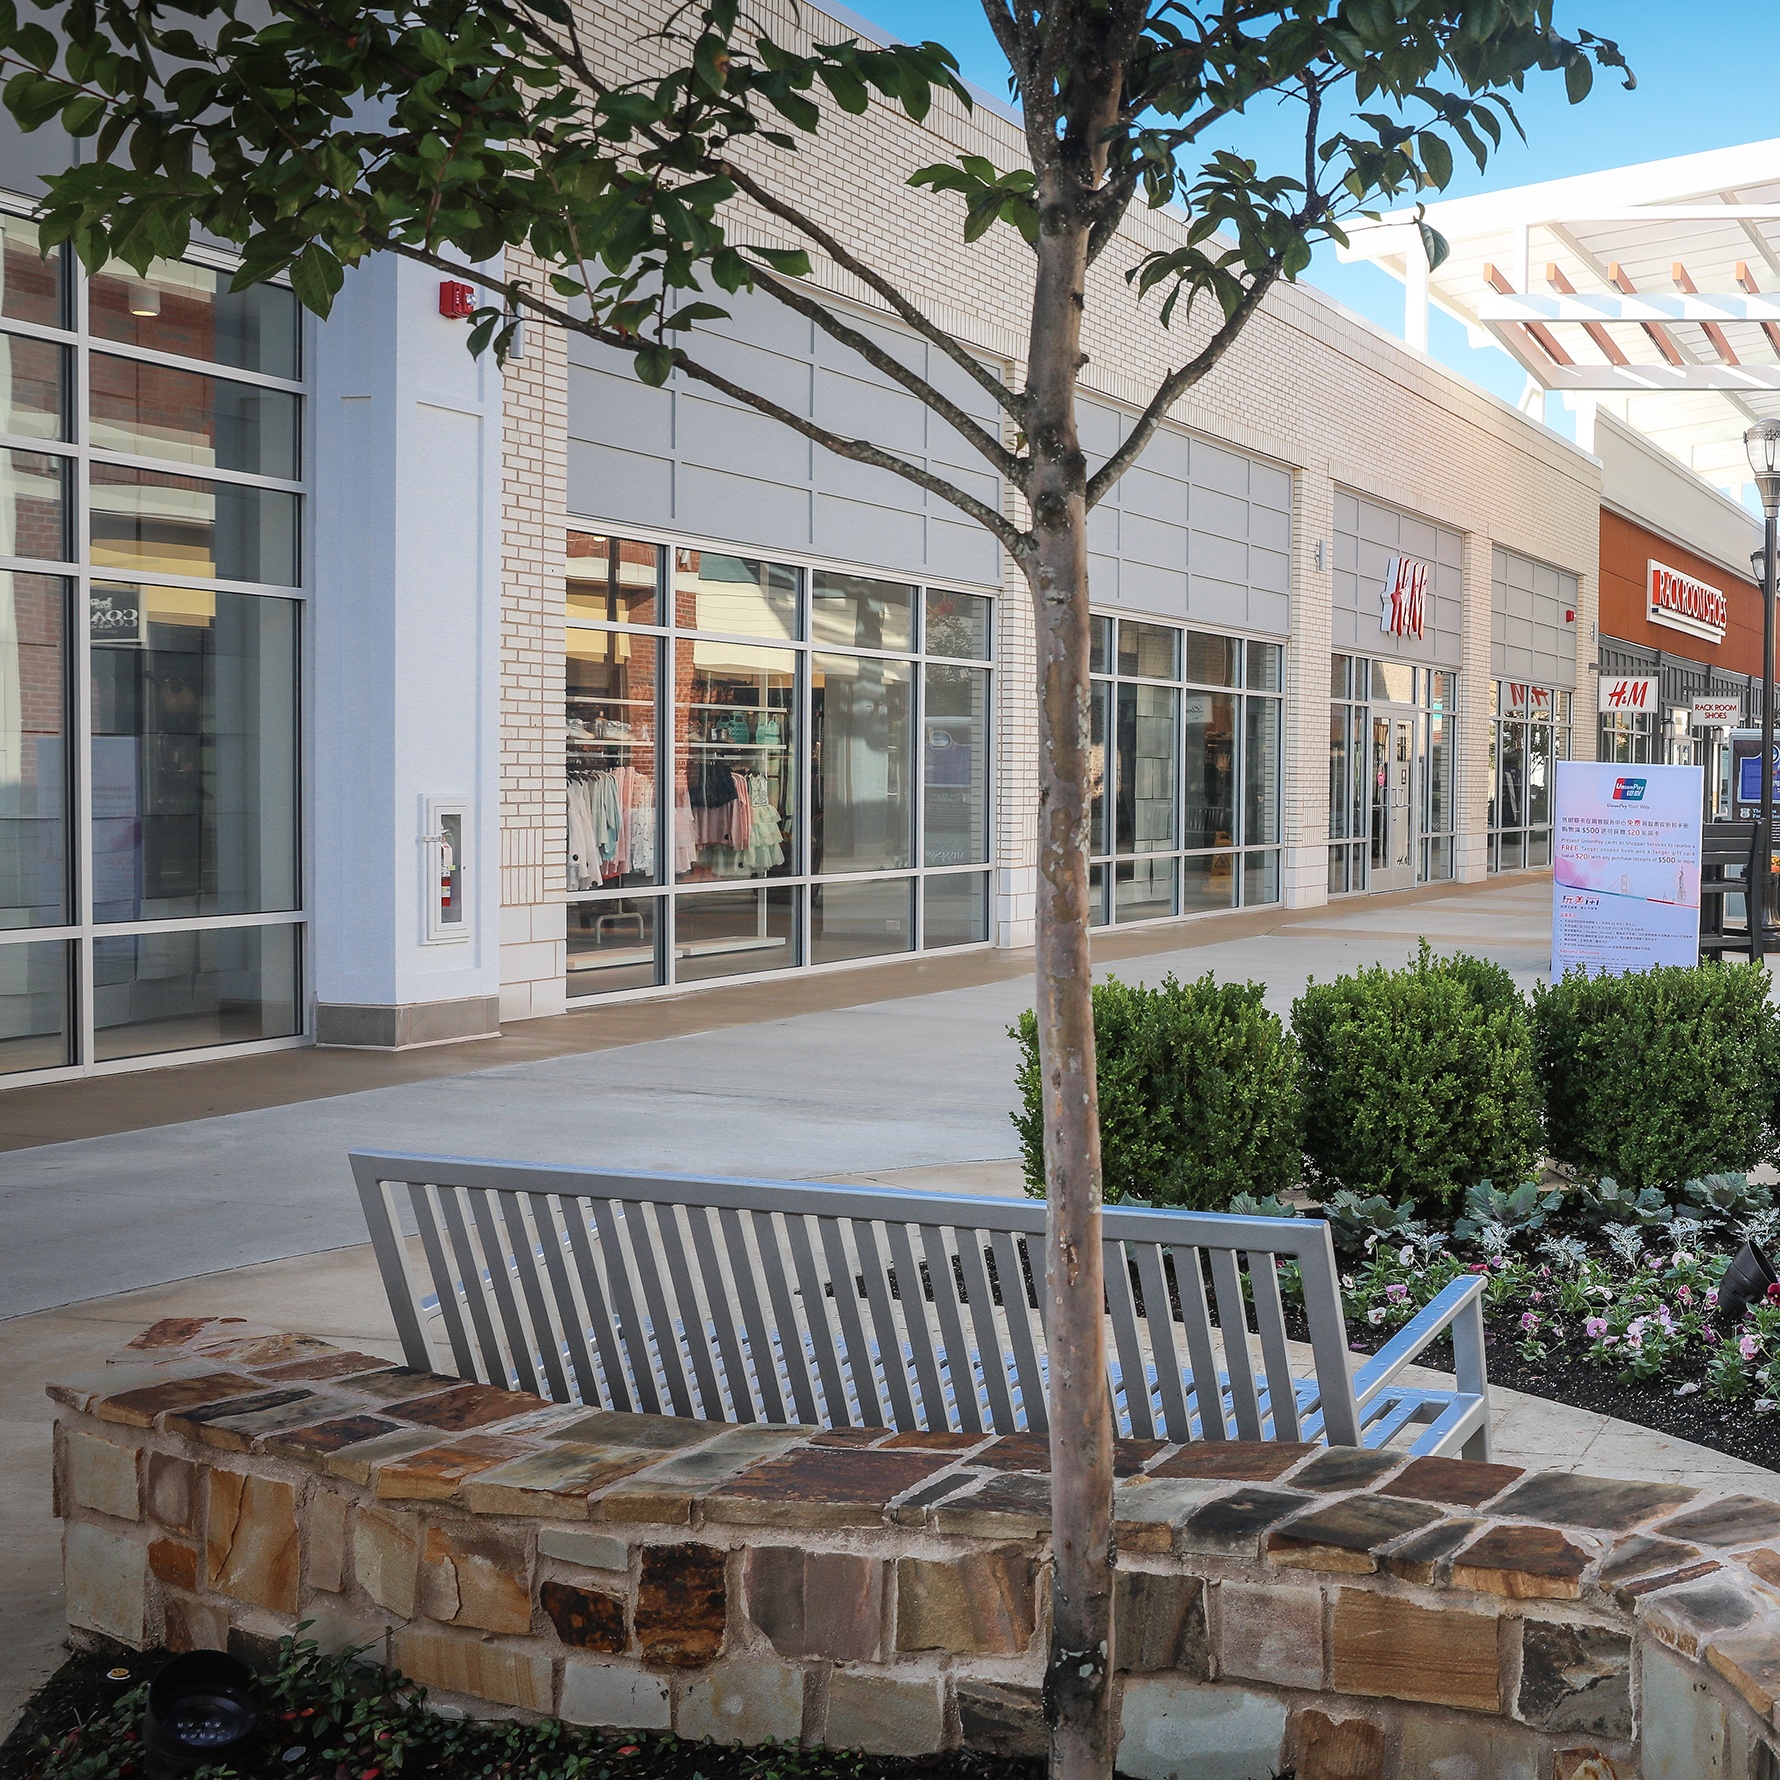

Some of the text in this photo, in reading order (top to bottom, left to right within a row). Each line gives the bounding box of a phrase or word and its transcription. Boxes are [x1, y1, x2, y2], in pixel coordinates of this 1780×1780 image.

[1389, 556, 1429, 641] H&M
[1659, 570, 1728, 629] RACK ROOM SHOES
[1608, 681, 1649, 708] H&M
[1695, 703, 1737, 712] RACK ROOM
[1704, 711, 1727, 719] SHOES
[1615, 782, 1645, 792] UnionPay
